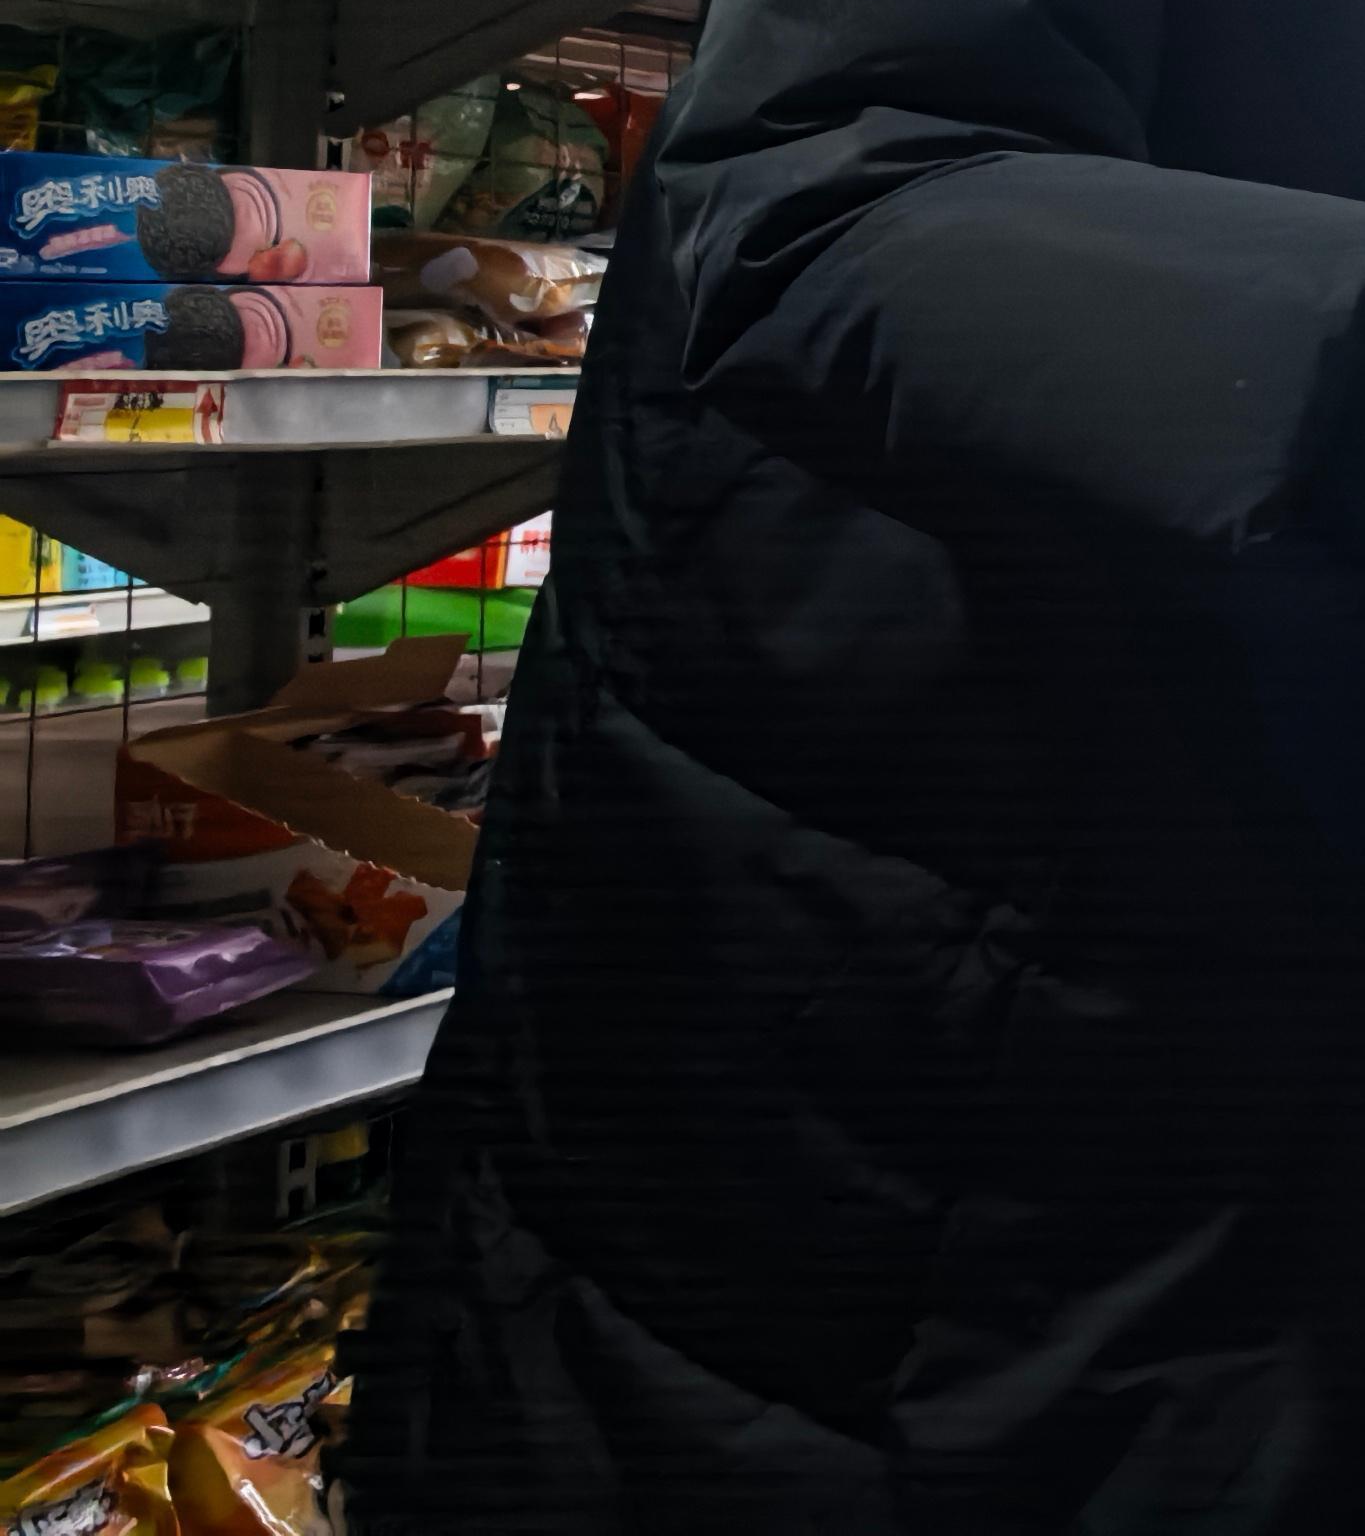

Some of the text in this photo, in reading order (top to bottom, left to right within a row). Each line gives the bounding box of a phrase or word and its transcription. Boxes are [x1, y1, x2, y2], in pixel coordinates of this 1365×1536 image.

[16, 174, 160, 231] 奥利奥
[19, 299, 170, 362] 奥利奥
